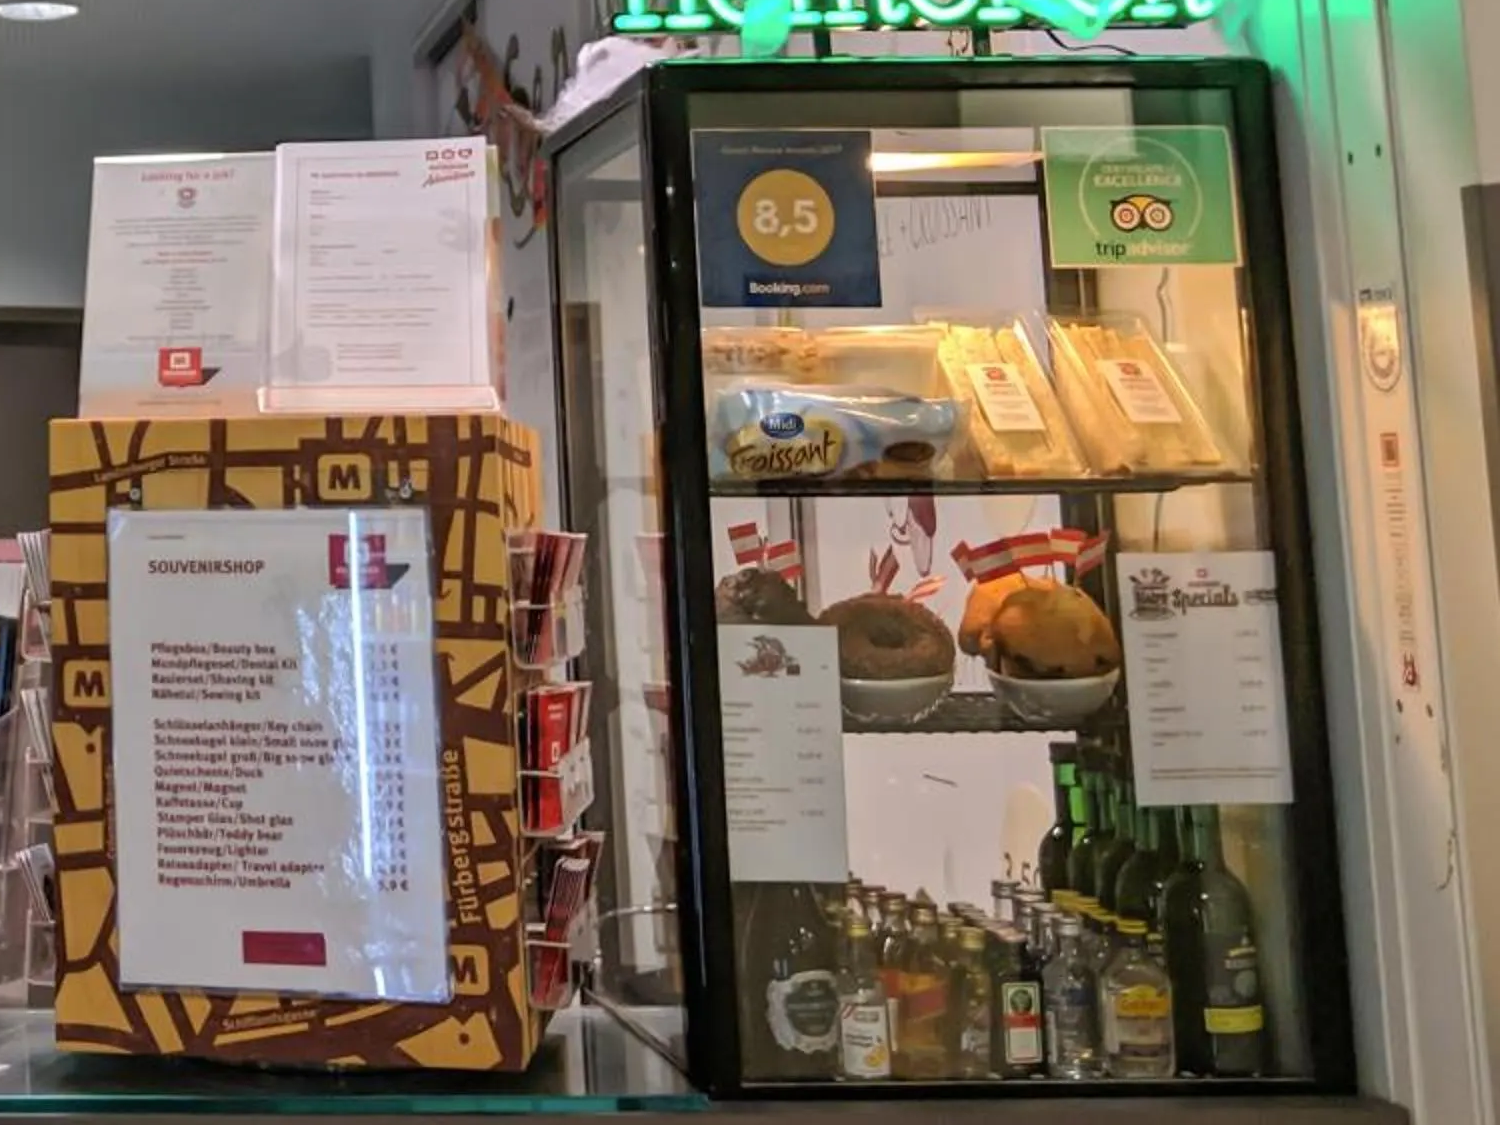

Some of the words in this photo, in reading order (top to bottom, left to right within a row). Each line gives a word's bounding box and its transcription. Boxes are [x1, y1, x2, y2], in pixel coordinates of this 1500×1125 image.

[753, 199, 819, 237] 8,5
[1095, 241, 1190, 259] tripadvisor
[748, 282, 830, 296] Booking.com
[148, 560, 266, 575] SOUVENIRSHOP
[443, 747, 482, 925] Fürbergstraße
